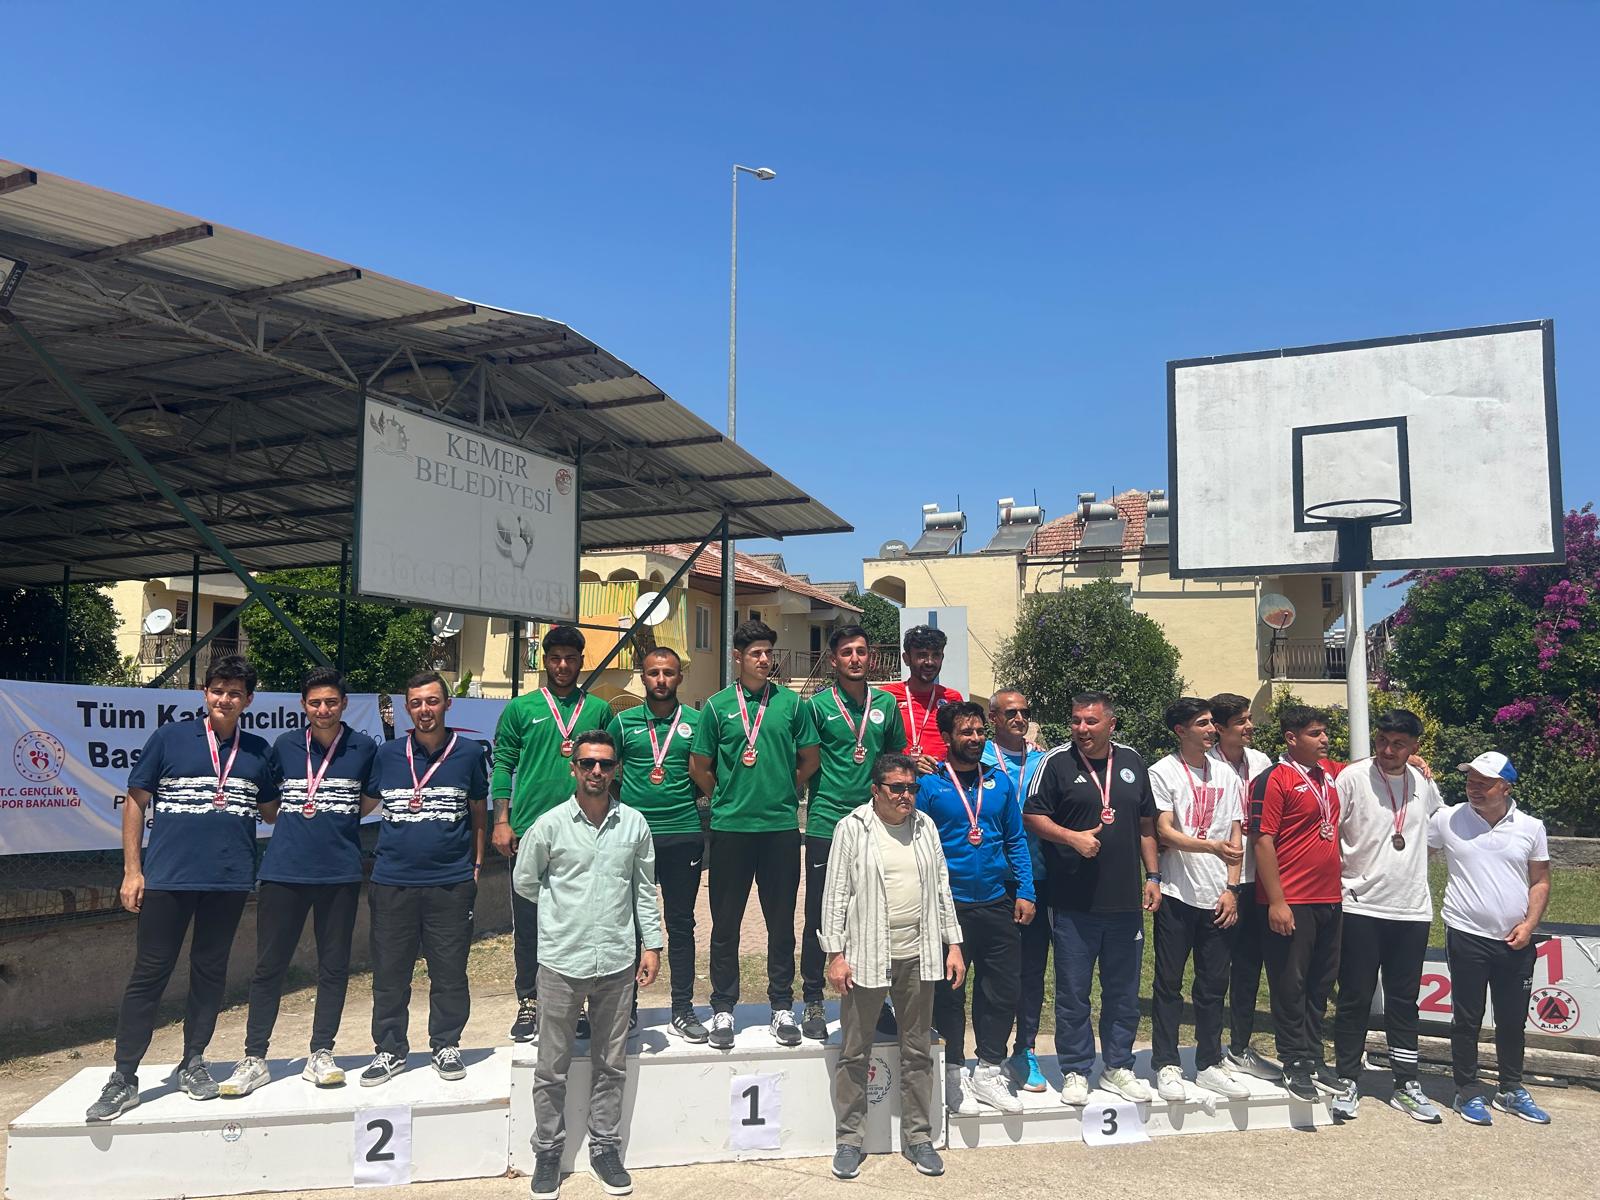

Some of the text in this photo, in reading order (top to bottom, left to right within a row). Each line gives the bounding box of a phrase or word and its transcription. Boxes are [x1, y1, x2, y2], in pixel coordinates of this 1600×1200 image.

[446, 432, 529, 479] KEMER
[415, 455, 553, 514] BELEDİYESİ
[77, 701, 145, 729] Tüm
[0, 786, 78, 798] T.C. GENÇLİK VE
[1536, 938, 1564, 985] 1
[1419, 973, 1453, 1013] 2
[742, 1085, 765, 1126] 1
[1101, 1108, 1118, 1136] 3
[366, 1118, 395, 1163] 2
